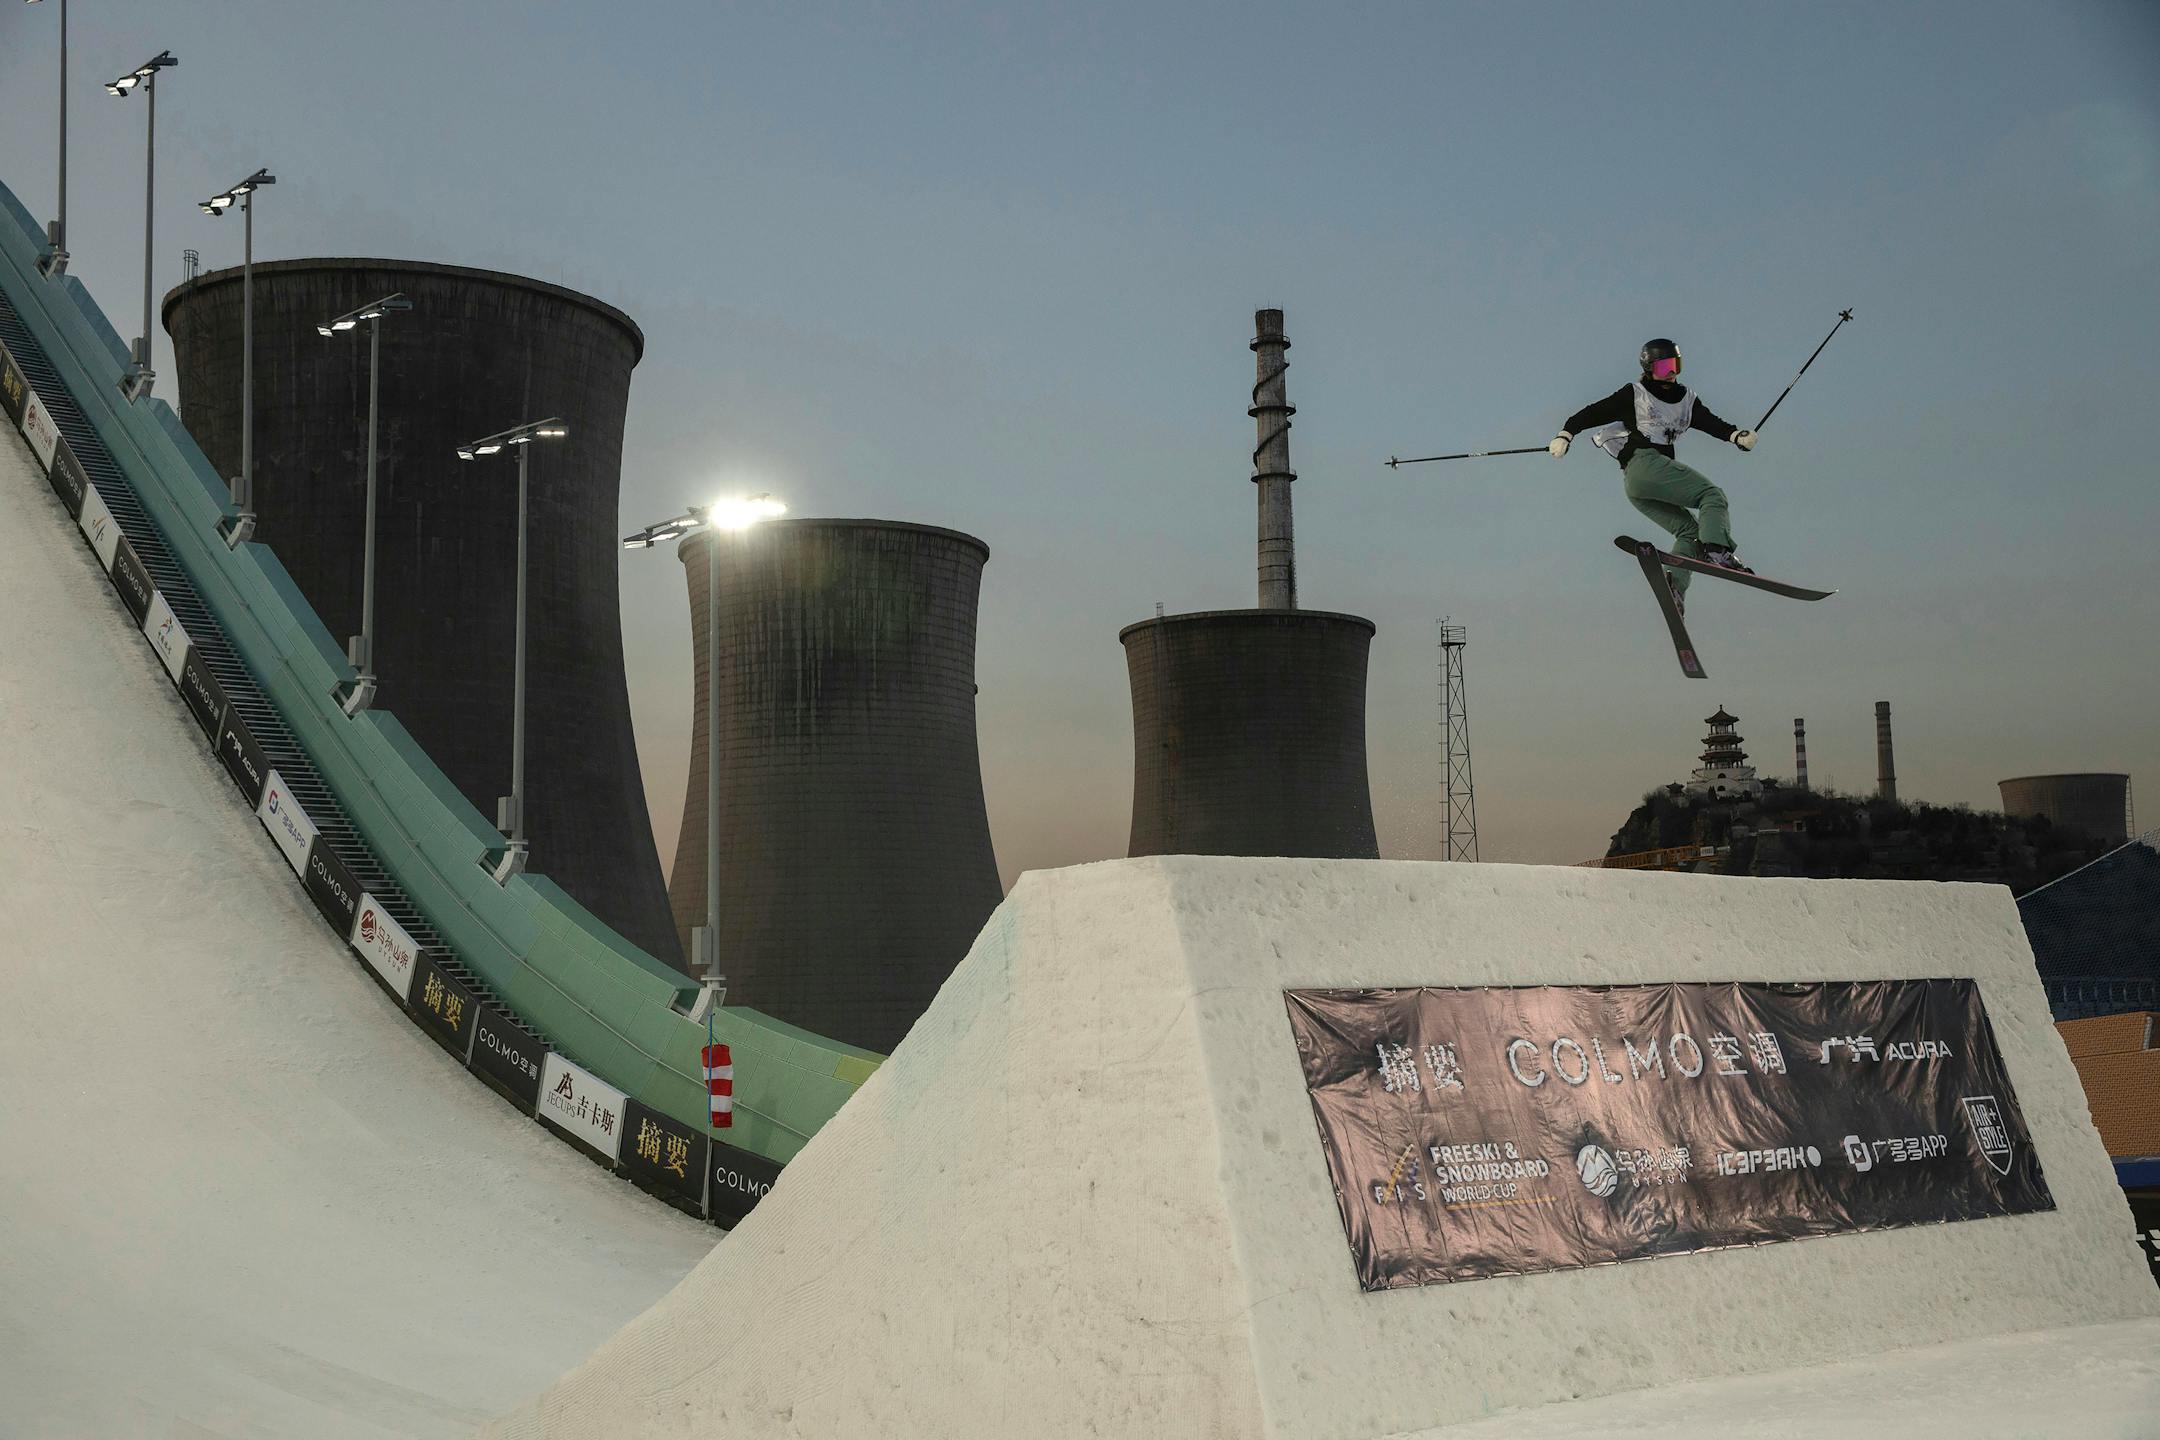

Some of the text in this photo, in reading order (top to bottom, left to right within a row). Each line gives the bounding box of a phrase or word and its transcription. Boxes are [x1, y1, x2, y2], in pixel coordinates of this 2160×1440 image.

[243, 756, 260, 787] ACURA
[1888, 1040, 1953, 1061] ACURA
[546, 1090, 616, 1136] JECUPS 吉卡斯
[636, 1116, 690, 1178] 摘要
[1978, 1125, 2008, 1149] STYLE
[1430, 1141, 1519, 1165] FREESKI &
[716, 1166, 771, 1199] COLMO
[1436, 1159, 1549, 1185] SNOWBOARD
[1441, 1182, 1517, 1203] WORLD CUP
